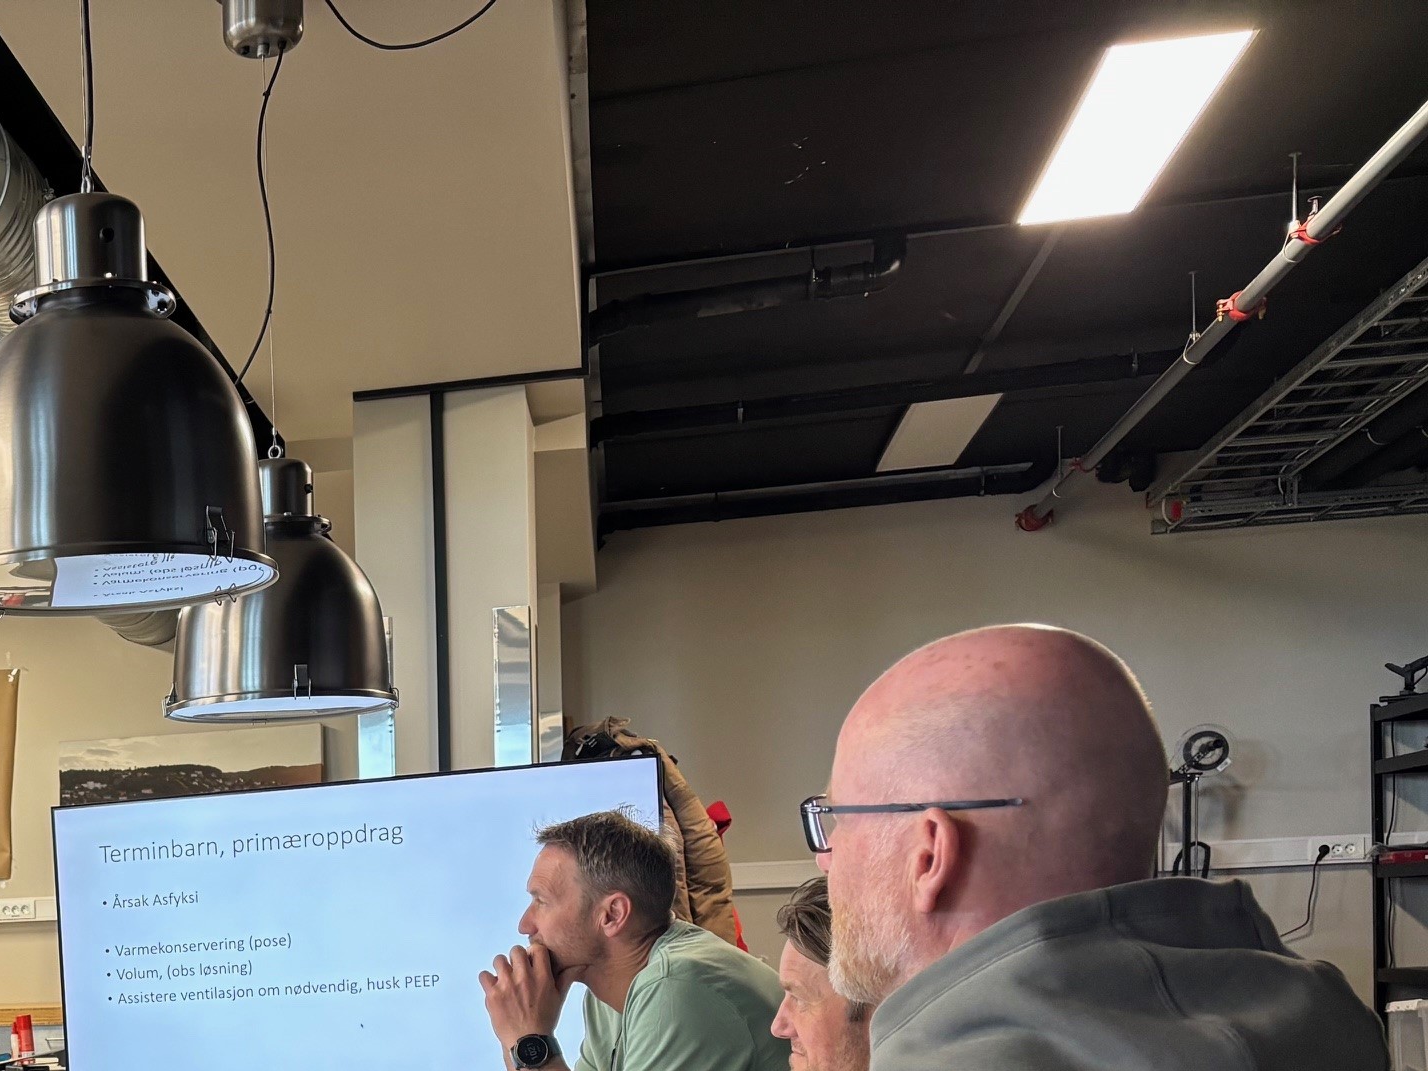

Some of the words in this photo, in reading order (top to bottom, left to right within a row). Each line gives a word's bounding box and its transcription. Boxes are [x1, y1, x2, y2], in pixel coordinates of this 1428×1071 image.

[98, 838, 225, 864] Terminbarn,
[232, 822, 404, 859] primæroppdrag
[112, 893, 150, 910] Årsak
[152, 890, 199, 908] Asfyksi
[114, 937, 246, 957] Varmekonservering
[248, 932, 292, 952] (pose)
[115, 966, 163, 981] Volum,
[166, 963, 196, 981] (obs
[199, 959, 253, 977] løsning)
[117, 991, 177, 1005] Assistere
[180, 985, 254, 1002] ventilasjon
[257, 986, 280, 997] om
[284, 978, 363, 996] nødvendig,
[366, 975, 401, 991] husk
[404, 974, 440, 989] PEEP
